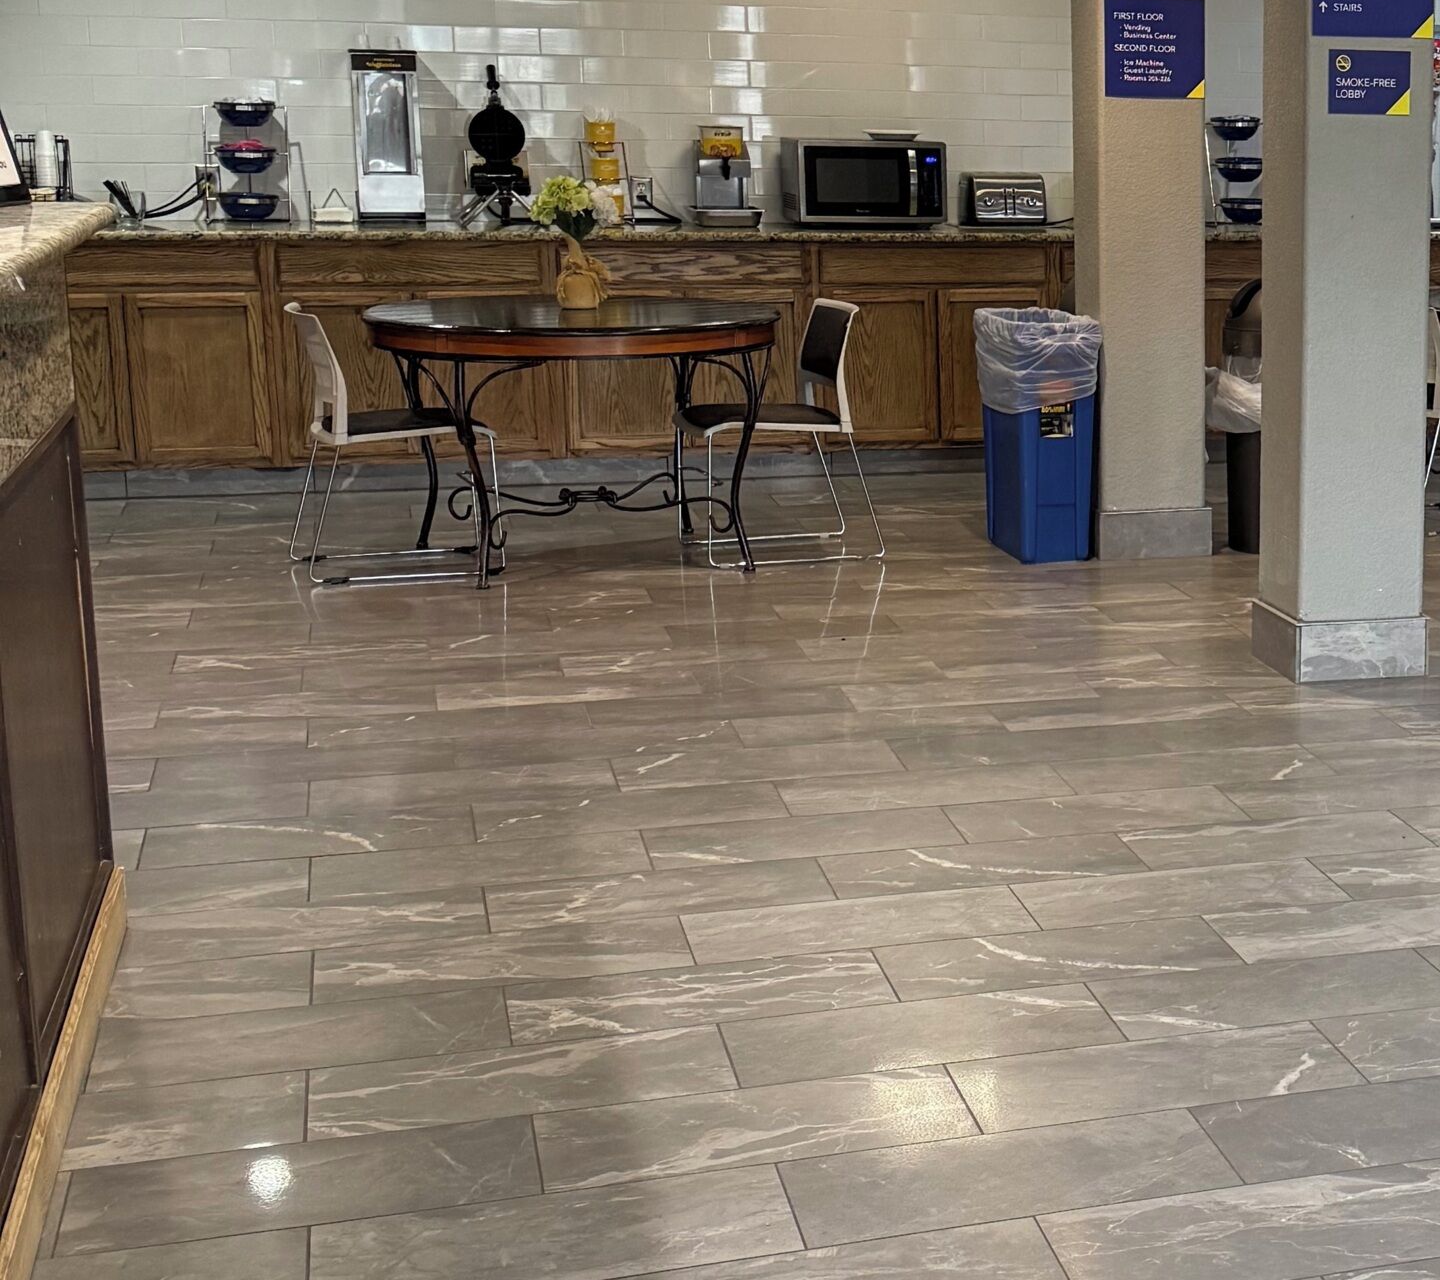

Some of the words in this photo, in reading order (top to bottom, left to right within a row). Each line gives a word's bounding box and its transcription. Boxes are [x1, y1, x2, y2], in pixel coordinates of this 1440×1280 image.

[1333, 3, 1363, 12] STAIRS
[1113, 11, 1135, 20] FIRST
[1137, 12, 1164, 21] FLOOR
[1123, 23, 1151, 33] Vending
[1123, 31, 1153, 39] Business
[1154, 32, 1176, 40] Center
[1114, 43, 1148, 52] SECOND
[1149, 44, 1176, 53] FLOOR
[1135, 59, 1164, 67] Machine
[1123, 66, 1144, 74] Guest
[1145, 67, 1172, 76] Laundry
[1335, 77, 1397, 89] SMOKE-FREE
[1335, 89, 1367, 99] LOBBY
